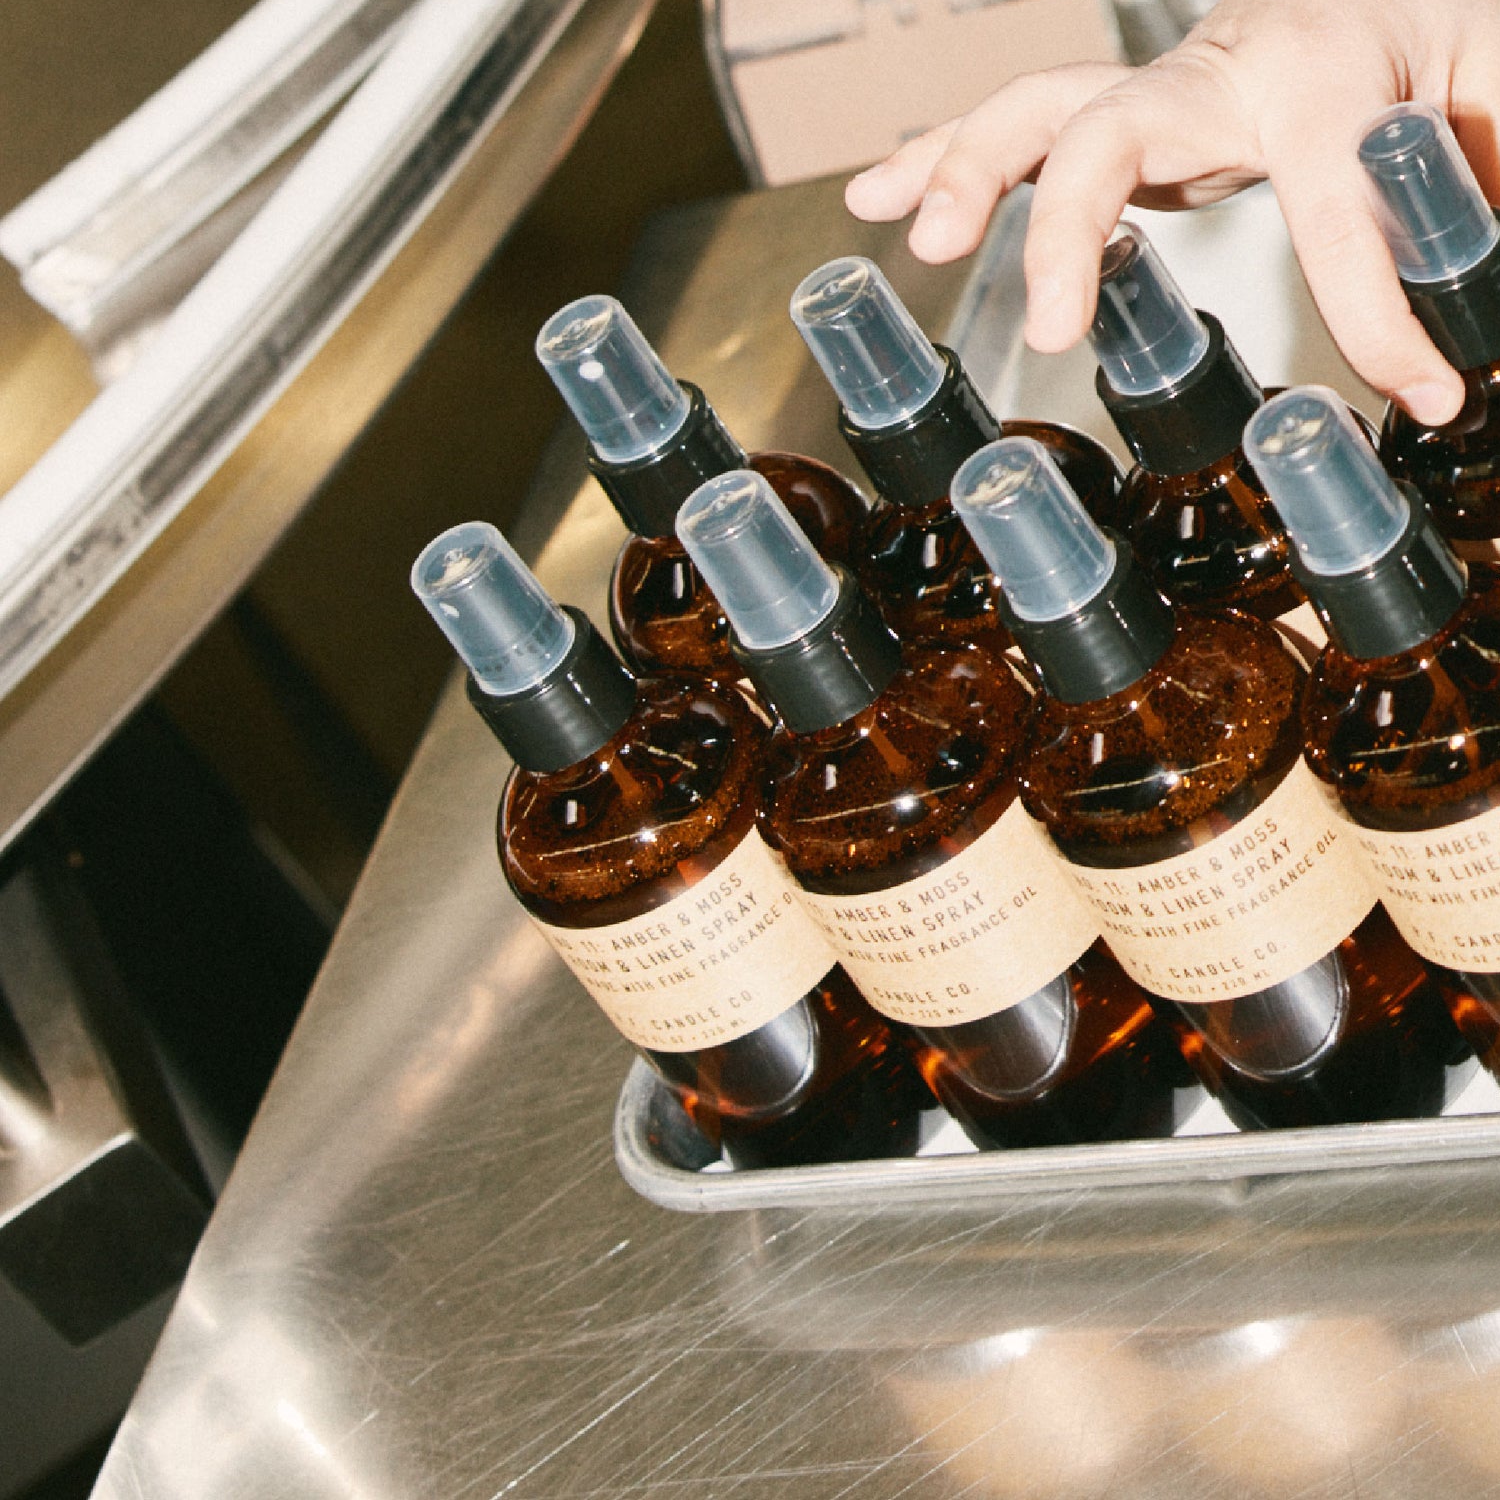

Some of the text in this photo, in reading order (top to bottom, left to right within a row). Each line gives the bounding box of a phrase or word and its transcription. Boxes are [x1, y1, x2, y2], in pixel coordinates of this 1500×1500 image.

[1137, 866, 1201, 895] AMBER
[1209, 856, 1223, 872] &
[1229, 818, 1279, 860] MOSS
[1371, 859, 1420, 882] ROOM
[1427, 868, 1441, 882] &
[1425, 830, 1491, 859] AMBER
[833, 904, 891, 923] AMBER
[898, 899, 912, 914] &
[919, 870, 971, 906] MOSS
[1140, 902, 1155, 918] &
[1161, 884, 1225, 915] LINEN
[1232, 837, 1292, 889] SPRAY
[1141, 925, 1177, 938] WITH
[1183, 915, 1221, 935] FINE
[1227, 853, 1314, 920] FRAGRANCE
[1316, 829, 1338, 855] OIL
[1429, 891, 1465, 905] WITH
[611, 923, 671, 951] AMBER
[677, 911, 691, 926] &
[695, 872, 743, 915] MOSS
[616, 958, 631, 973] &
[635, 938, 696, 970] LINEN
[702, 891, 758, 941] SPRAY
[839, 925, 854, 942] &
[858, 923, 916, 943] LINEN
[923, 890, 985, 931] SPRAY
[878, 950, 914, 963] FINE
[918, 906, 1009, 959] FRAGRANCE
[1013, 885, 1038, 908] OIL
[657, 967, 696, 988] FINE
[700, 904, 782, 970] FRAGRANCE
[1168, 956, 1245, 979] CANDLE
[650, 1006, 721, 1031] CANDLE
[873, 983, 980, 1004] CANDLE CO.
